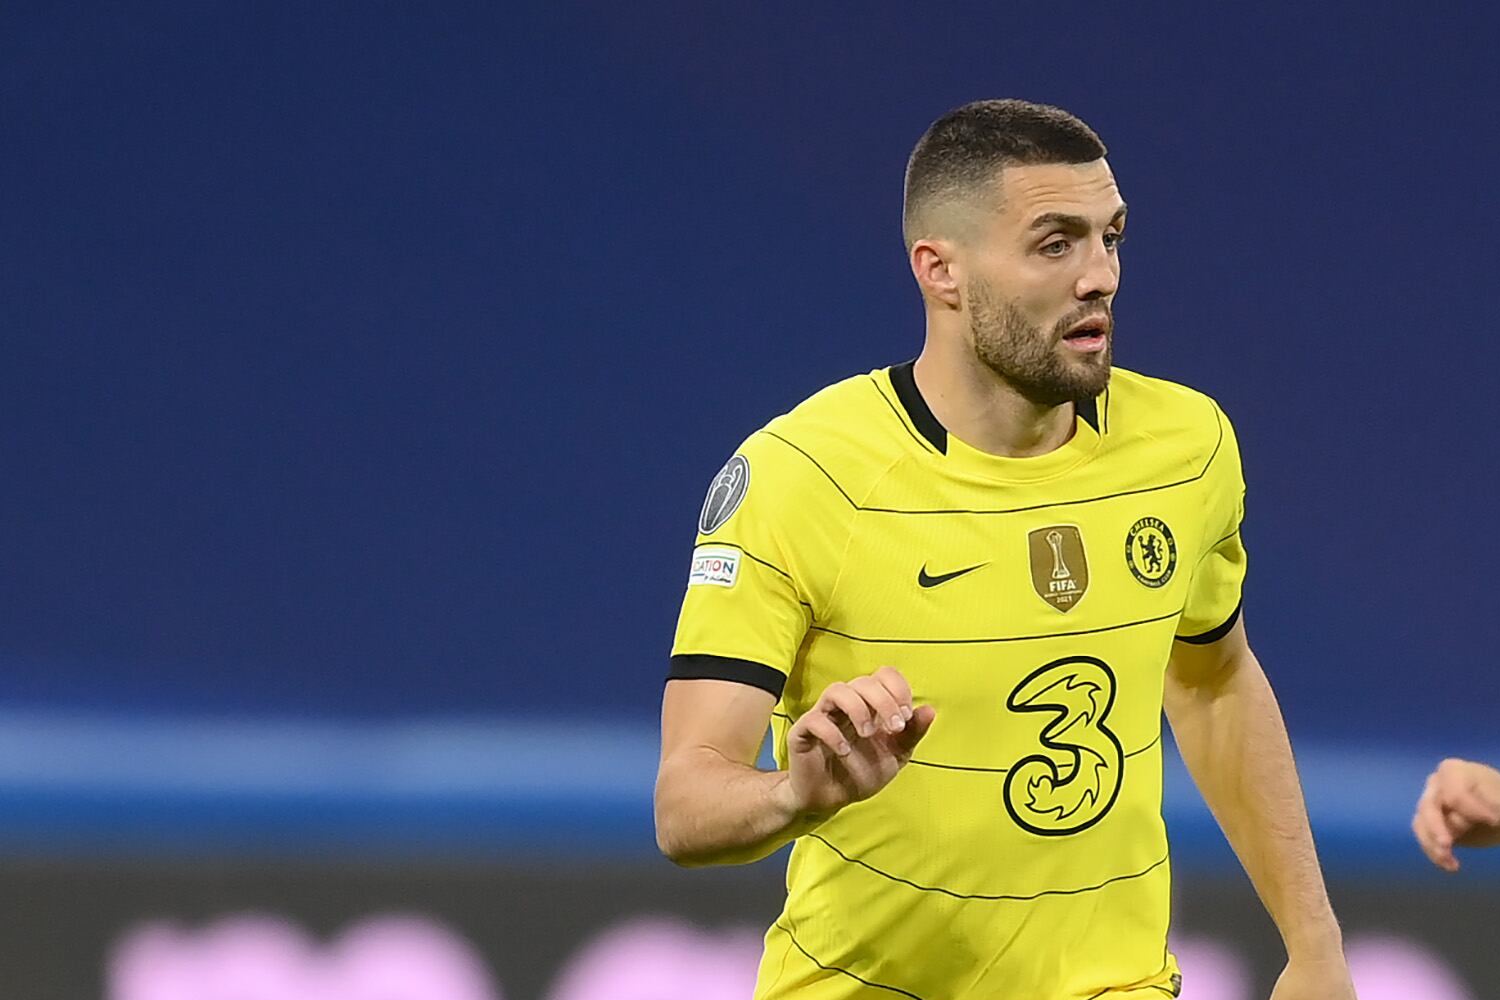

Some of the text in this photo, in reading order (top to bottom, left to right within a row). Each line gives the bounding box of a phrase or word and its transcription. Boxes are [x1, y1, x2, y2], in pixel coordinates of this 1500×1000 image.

[1130, 518, 1165, 536] CHELSEA
[1049, 579, 1076, 592] FIFA
[1003, 655, 1124, 837] 3
